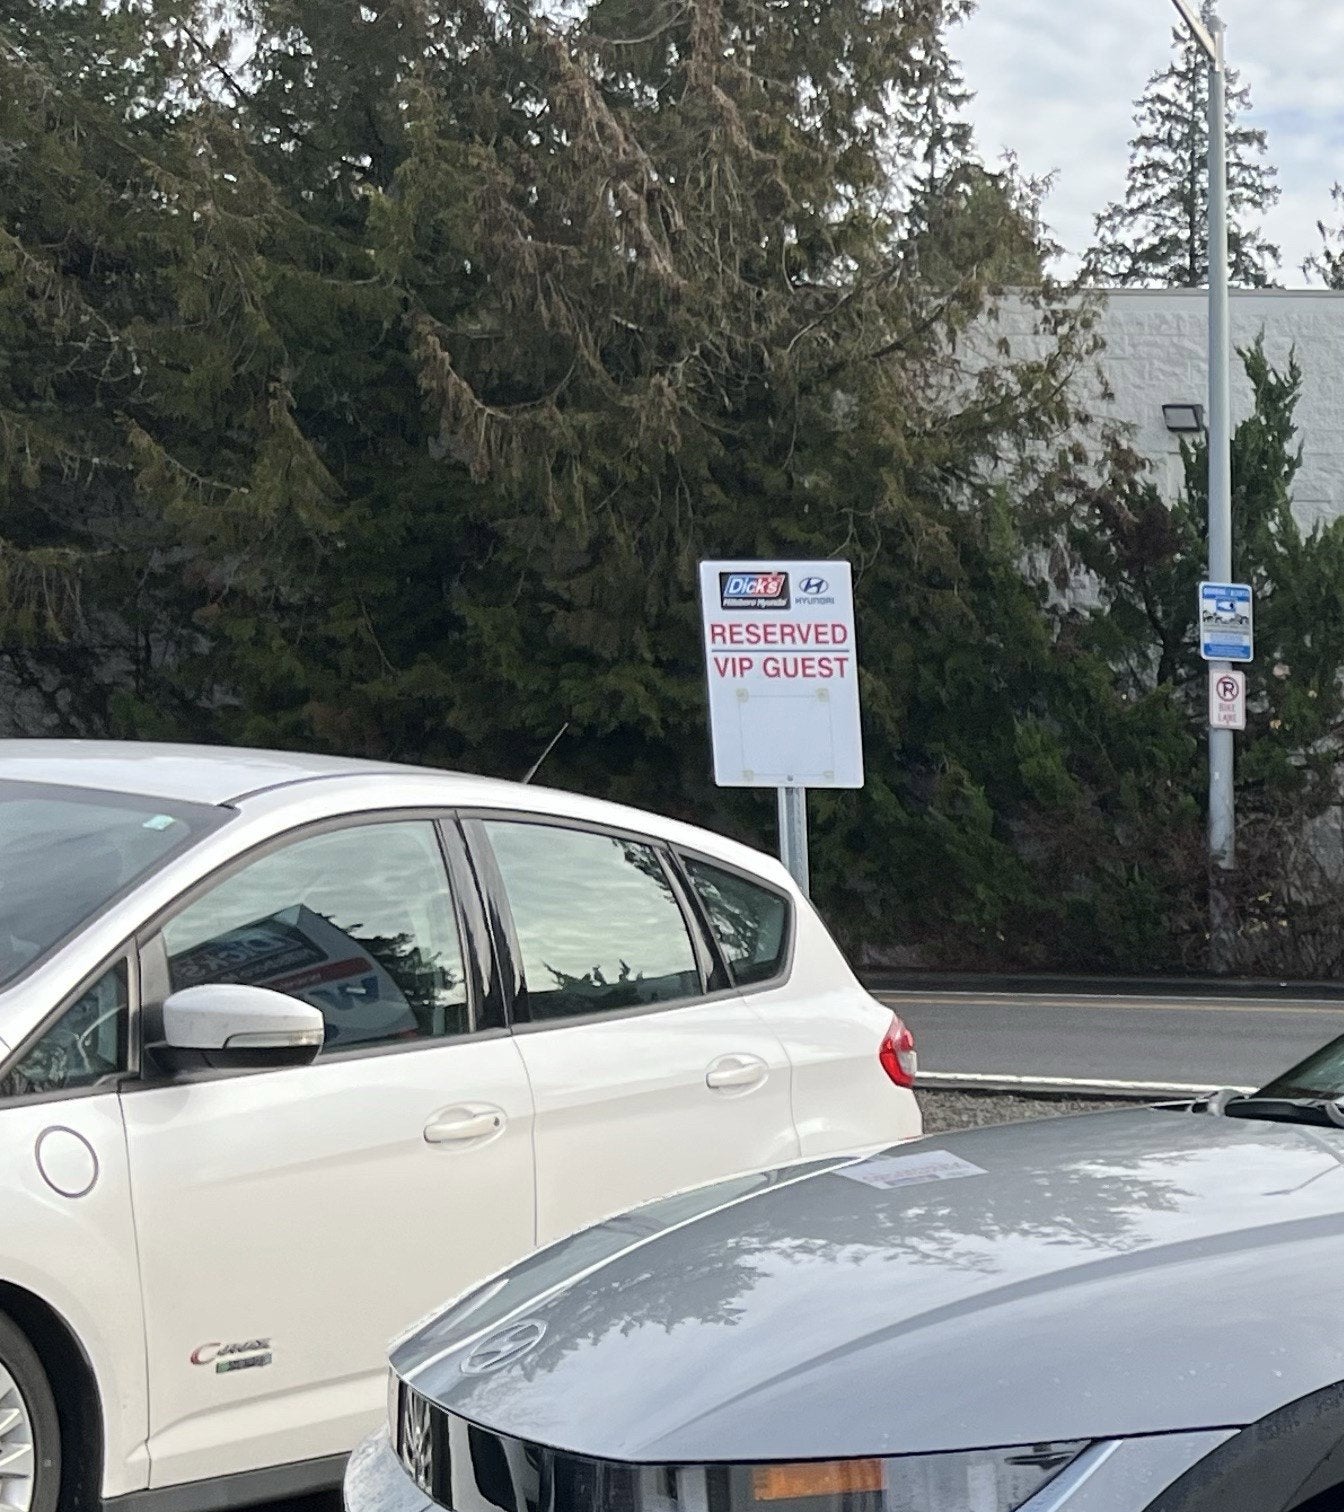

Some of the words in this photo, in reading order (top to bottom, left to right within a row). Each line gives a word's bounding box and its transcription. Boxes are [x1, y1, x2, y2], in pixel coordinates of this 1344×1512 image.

[710, 623, 848, 645] RESERVED
[714, 657, 753, 678] VIP
[762, 657, 849, 678] GUEST
